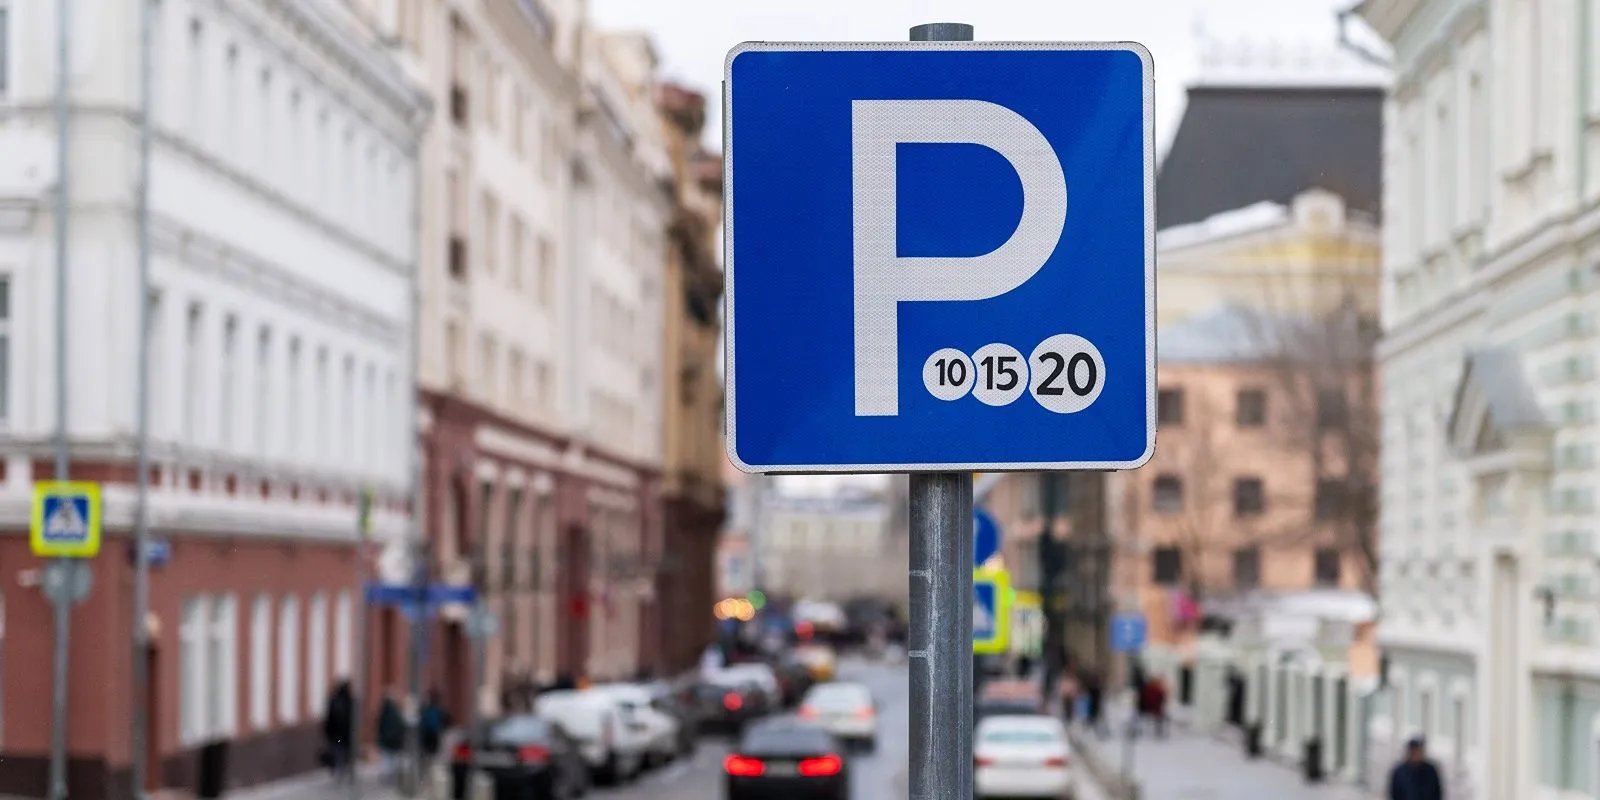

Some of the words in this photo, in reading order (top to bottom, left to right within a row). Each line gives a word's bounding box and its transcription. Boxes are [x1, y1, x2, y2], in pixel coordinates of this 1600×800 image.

[851, 99, 1067, 416] P
[934, 358, 967, 387] 10
[980, 356, 1019, 391] 15
[1036, 351, 1098, 397] 20
